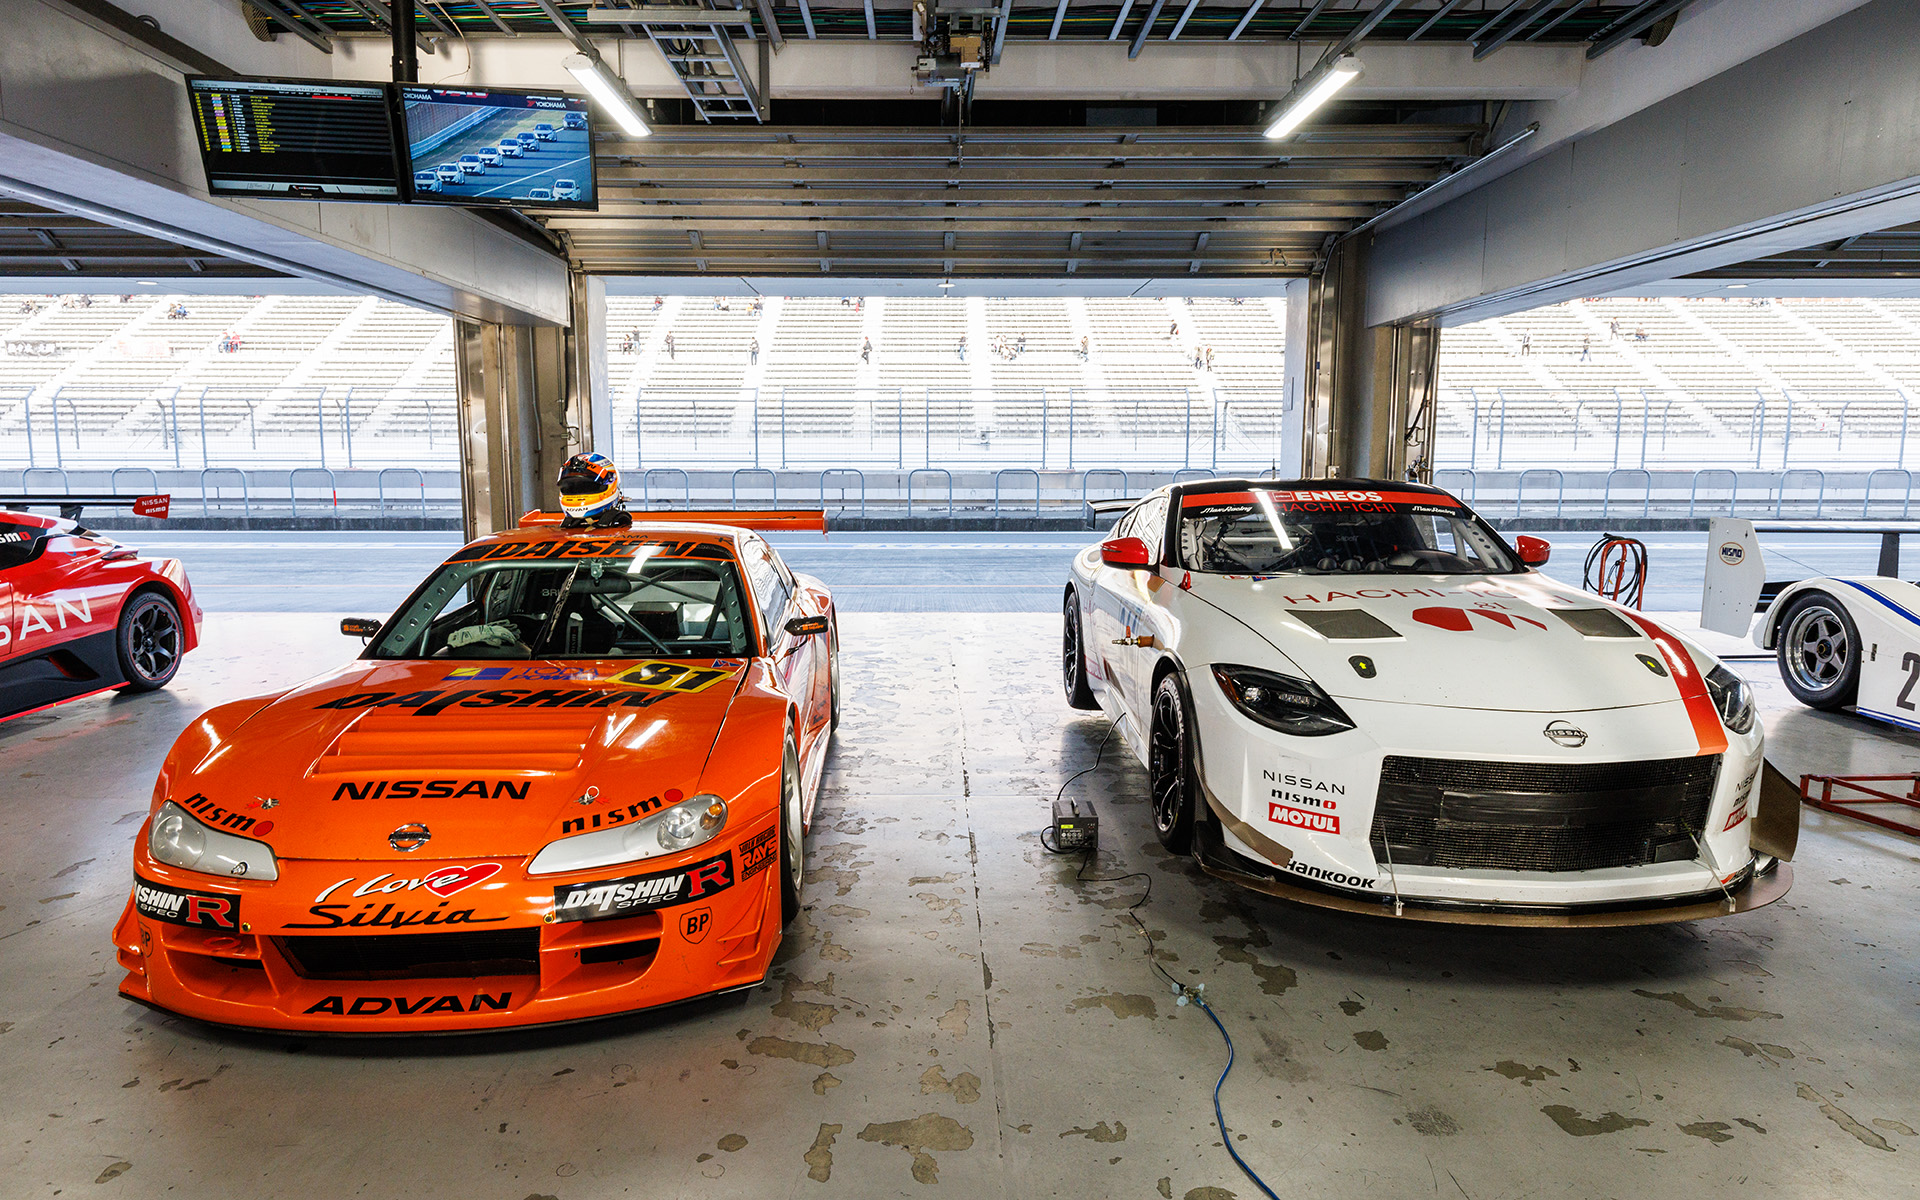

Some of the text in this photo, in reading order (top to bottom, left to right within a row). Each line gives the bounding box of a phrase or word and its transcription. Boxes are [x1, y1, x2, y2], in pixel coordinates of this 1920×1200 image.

[535, 101, 567, 109] YOKOHAMA
[141, 497, 168, 506] NISSAN
[1295, 491, 1383, 502] ENEOS
[145, 506, 166, 514] nismo
[1472, 601, 1513, 610] 81
[520, 666, 600, 676] TODA
[618, 662, 728, 691] 81
[332, 780, 531, 802] NISSAN
[1263, 769, 1345, 795] NISSAN
[1271, 788, 1337, 810] nismo
[1271, 806, 1337, 832] MOTUL
[741, 852, 778, 881] ENGINEERING
[742, 840, 777, 870] RAYS
[315, 873, 469, 903] I Love
[617, 859, 731, 909] SPEC R
[140, 893, 235, 928] SPEC R
[281, 901, 510, 929] Silvia
[686, 912, 710, 936] BP
[303, 992, 512, 1016] ADVAN
